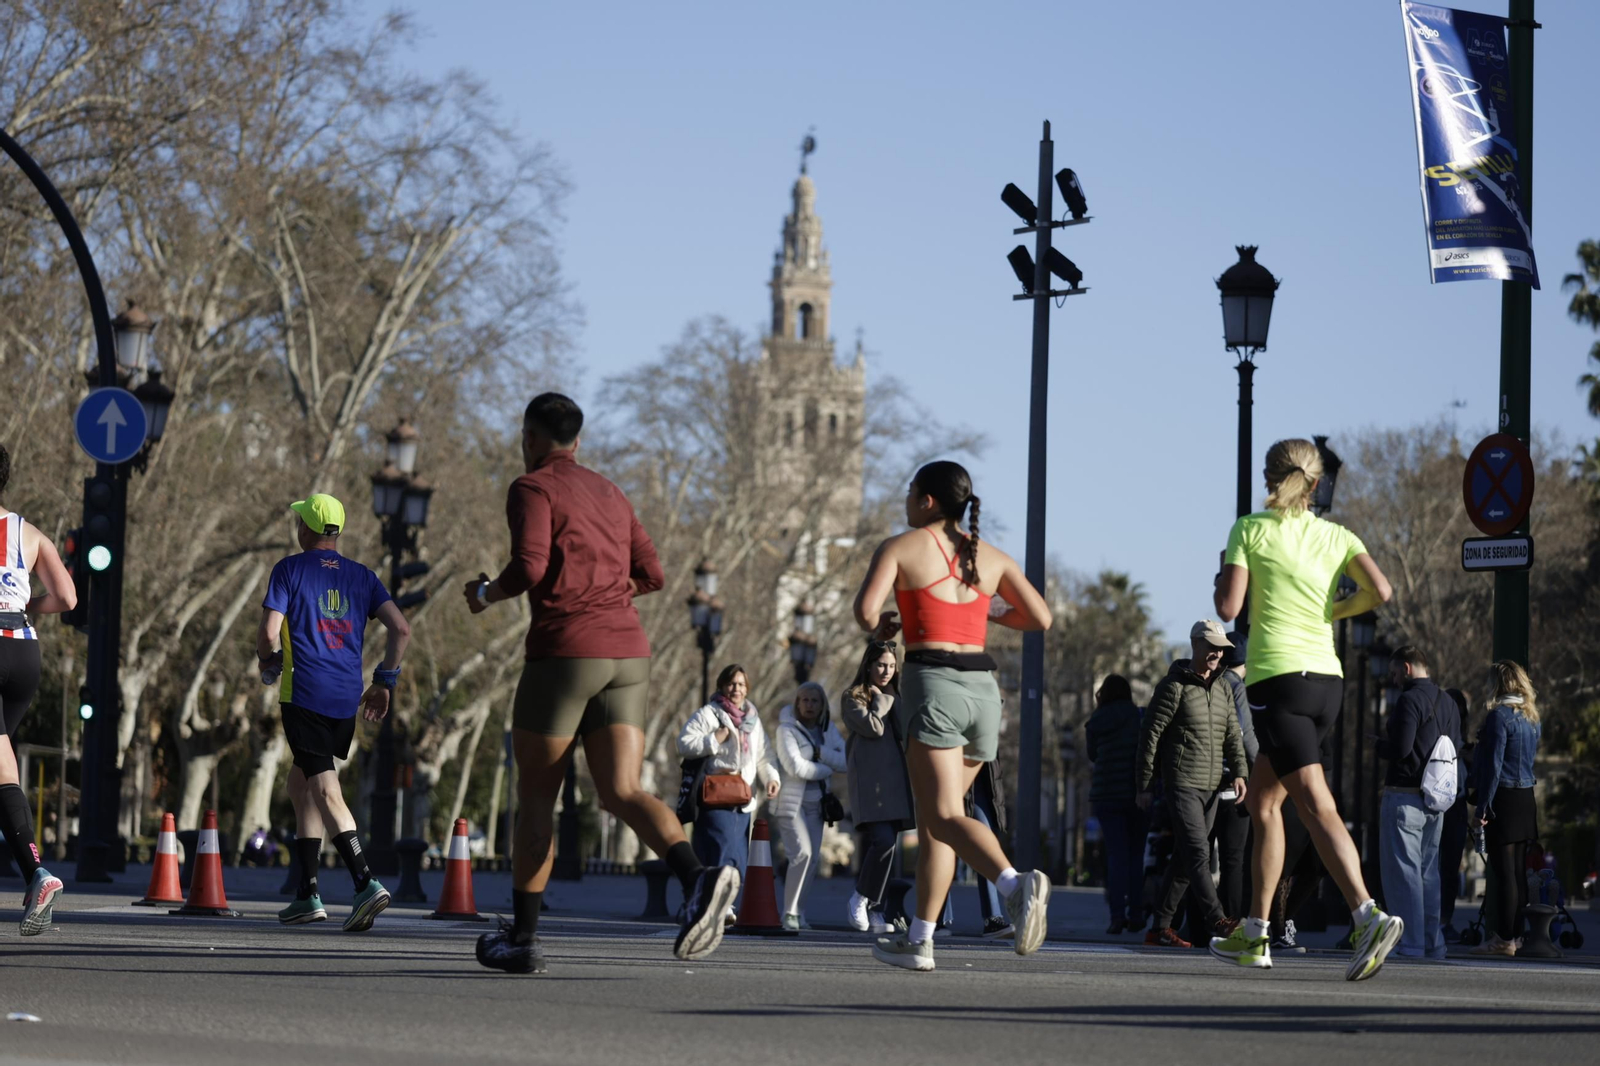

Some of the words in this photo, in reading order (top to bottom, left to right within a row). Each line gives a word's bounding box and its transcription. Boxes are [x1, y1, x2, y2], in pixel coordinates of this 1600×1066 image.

[1452, 252, 1470, 260] asics
[1465, 547, 1481, 560] ZONA
[1482, 546, 1491, 559] DE
[1492, 545, 1528, 559] SEGURIDAD
[317, 619, 353, 634] MARATHON
